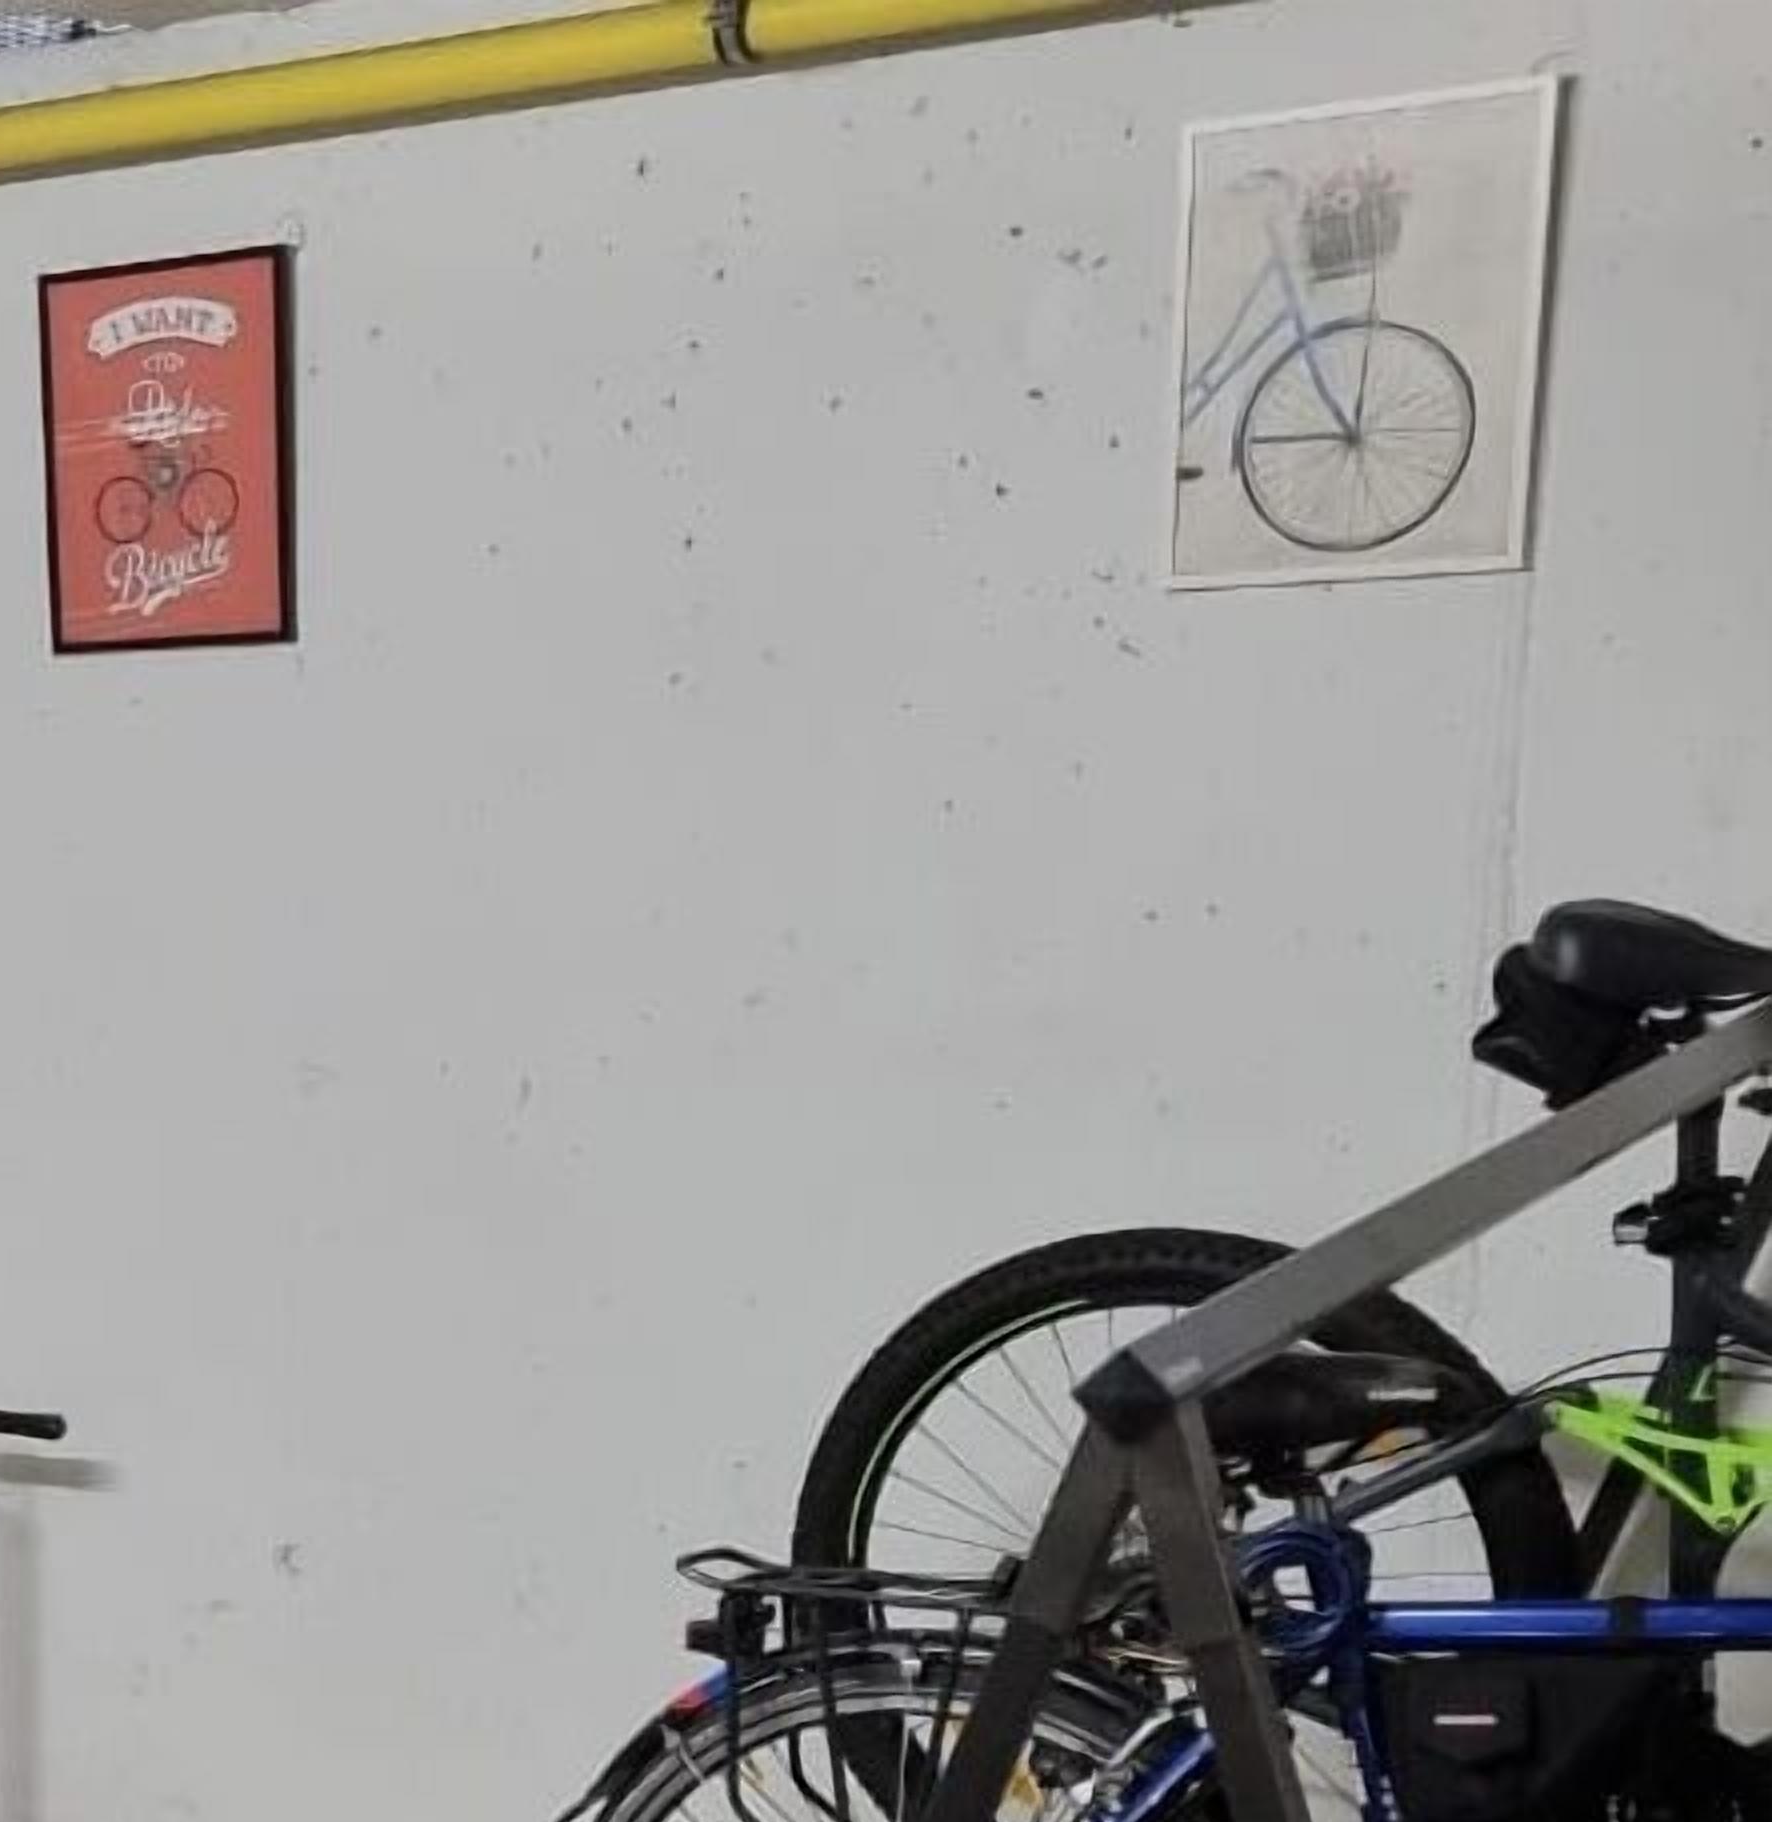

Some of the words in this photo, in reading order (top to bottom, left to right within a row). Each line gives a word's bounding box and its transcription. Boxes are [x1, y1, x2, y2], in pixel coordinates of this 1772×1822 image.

[110, 318, 123, 345] I
[130, 303, 216, 337] WANT
[105, 518, 230, 616] Bicycle
